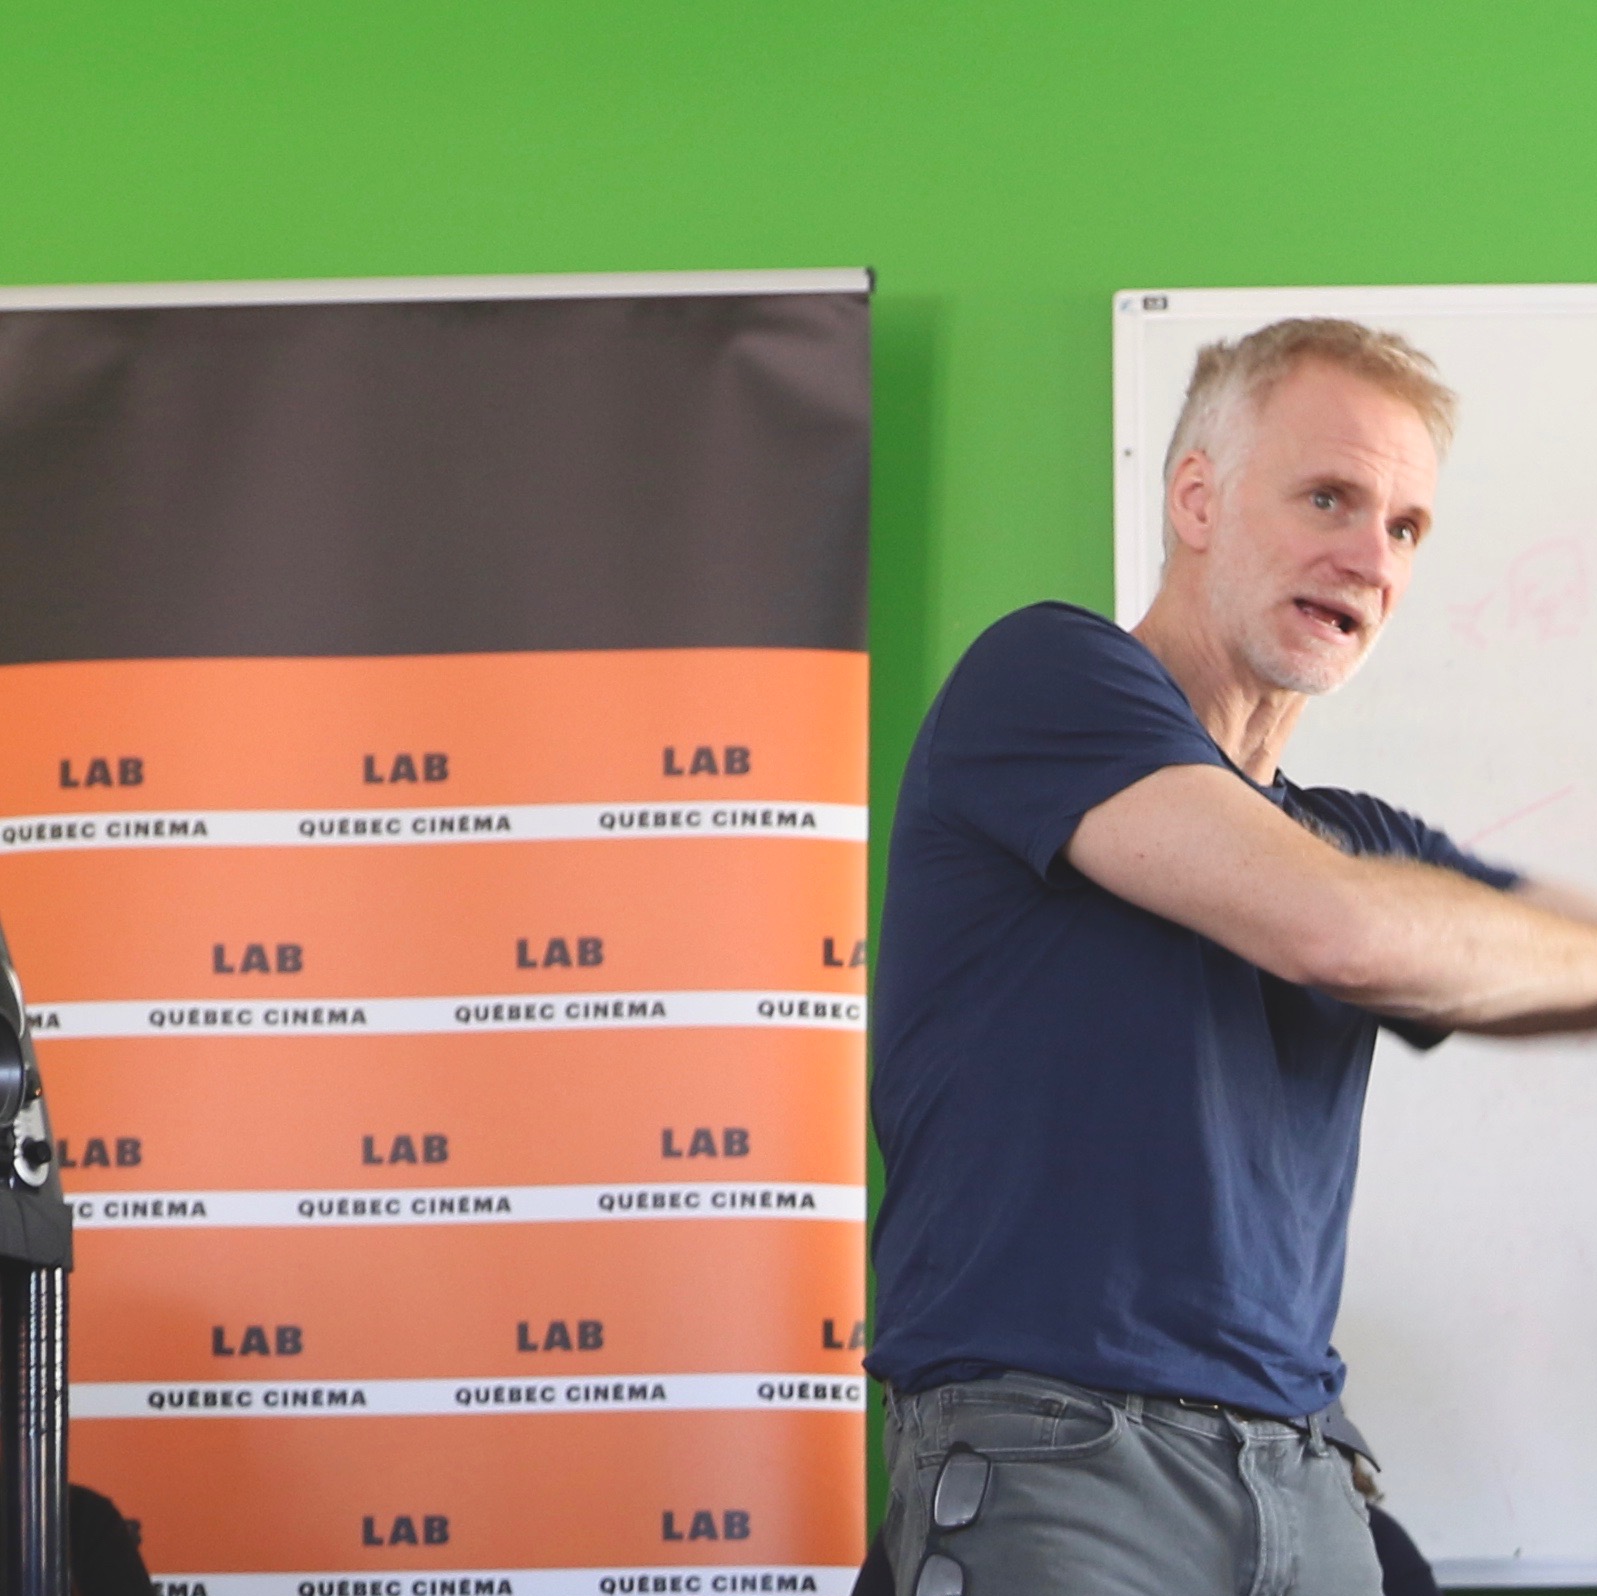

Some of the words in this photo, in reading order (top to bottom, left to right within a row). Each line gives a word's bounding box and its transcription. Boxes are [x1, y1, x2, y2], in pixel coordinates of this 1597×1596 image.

[59, 757, 144, 789] LAB
[364, 753, 449, 785] LAB
[663, 746, 751, 777] LAB
[298, 818, 401, 838] QUÉBEC
[411, 815, 511, 834] CINÉMA
[599, 811, 701, 831] QUÉBEC
[711, 809, 816, 828] CINÉMA
[1, 822, 95, 845] QUÉBEC
[106, 820, 208, 838] CINÉMA
[213, 943, 303, 975] LAB
[516, 937, 604, 970] LAB
[148, 1008, 252, 1028] QUÉBEC
[263, 1007, 367, 1026] CINÉMA
[454, 1003, 554, 1024] QUÉBEC
[565, 1001, 666, 1020] CINÉMA
[758, 1001, 860, 1020] QUÉBEC
[56, 1136, 142, 1168] LAB
[362, 1134, 449, 1165] LAB
[661, 1128, 750, 1159] LAB
[103, 1199, 207, 1219] CINÉMA
[297, 1198, 400, 1218] QUÉBEC
[411, 1196, 512, 1215] CINÉMA
[598, 1192, 700, 1213] QUÉBEC
[711, 1191, 816, 1209] CINÉMA
[212, 1325, 303, 1357] LAB
[517, 1320, 604, 1353] LAB
[147, 1389, 252, 1410] QUÉBEC
[262, 1389, 367, 1408] CINÉMA
[455, 1385, 555, 1407] QUÉBEC
[565, 1383, 666, 1402] CINÉMA
[758, 1383, 859, 1402] QUÉBEC
[362, 1515, 450, 1547] LAB
[662, 1510, 751, 1542] LAB
[411, 1578, 513, 1596] CINÉMA
[599, 1575, 701, 1596] QUÉBEC
[711, 1574, 817, 1593] CINÉMA
